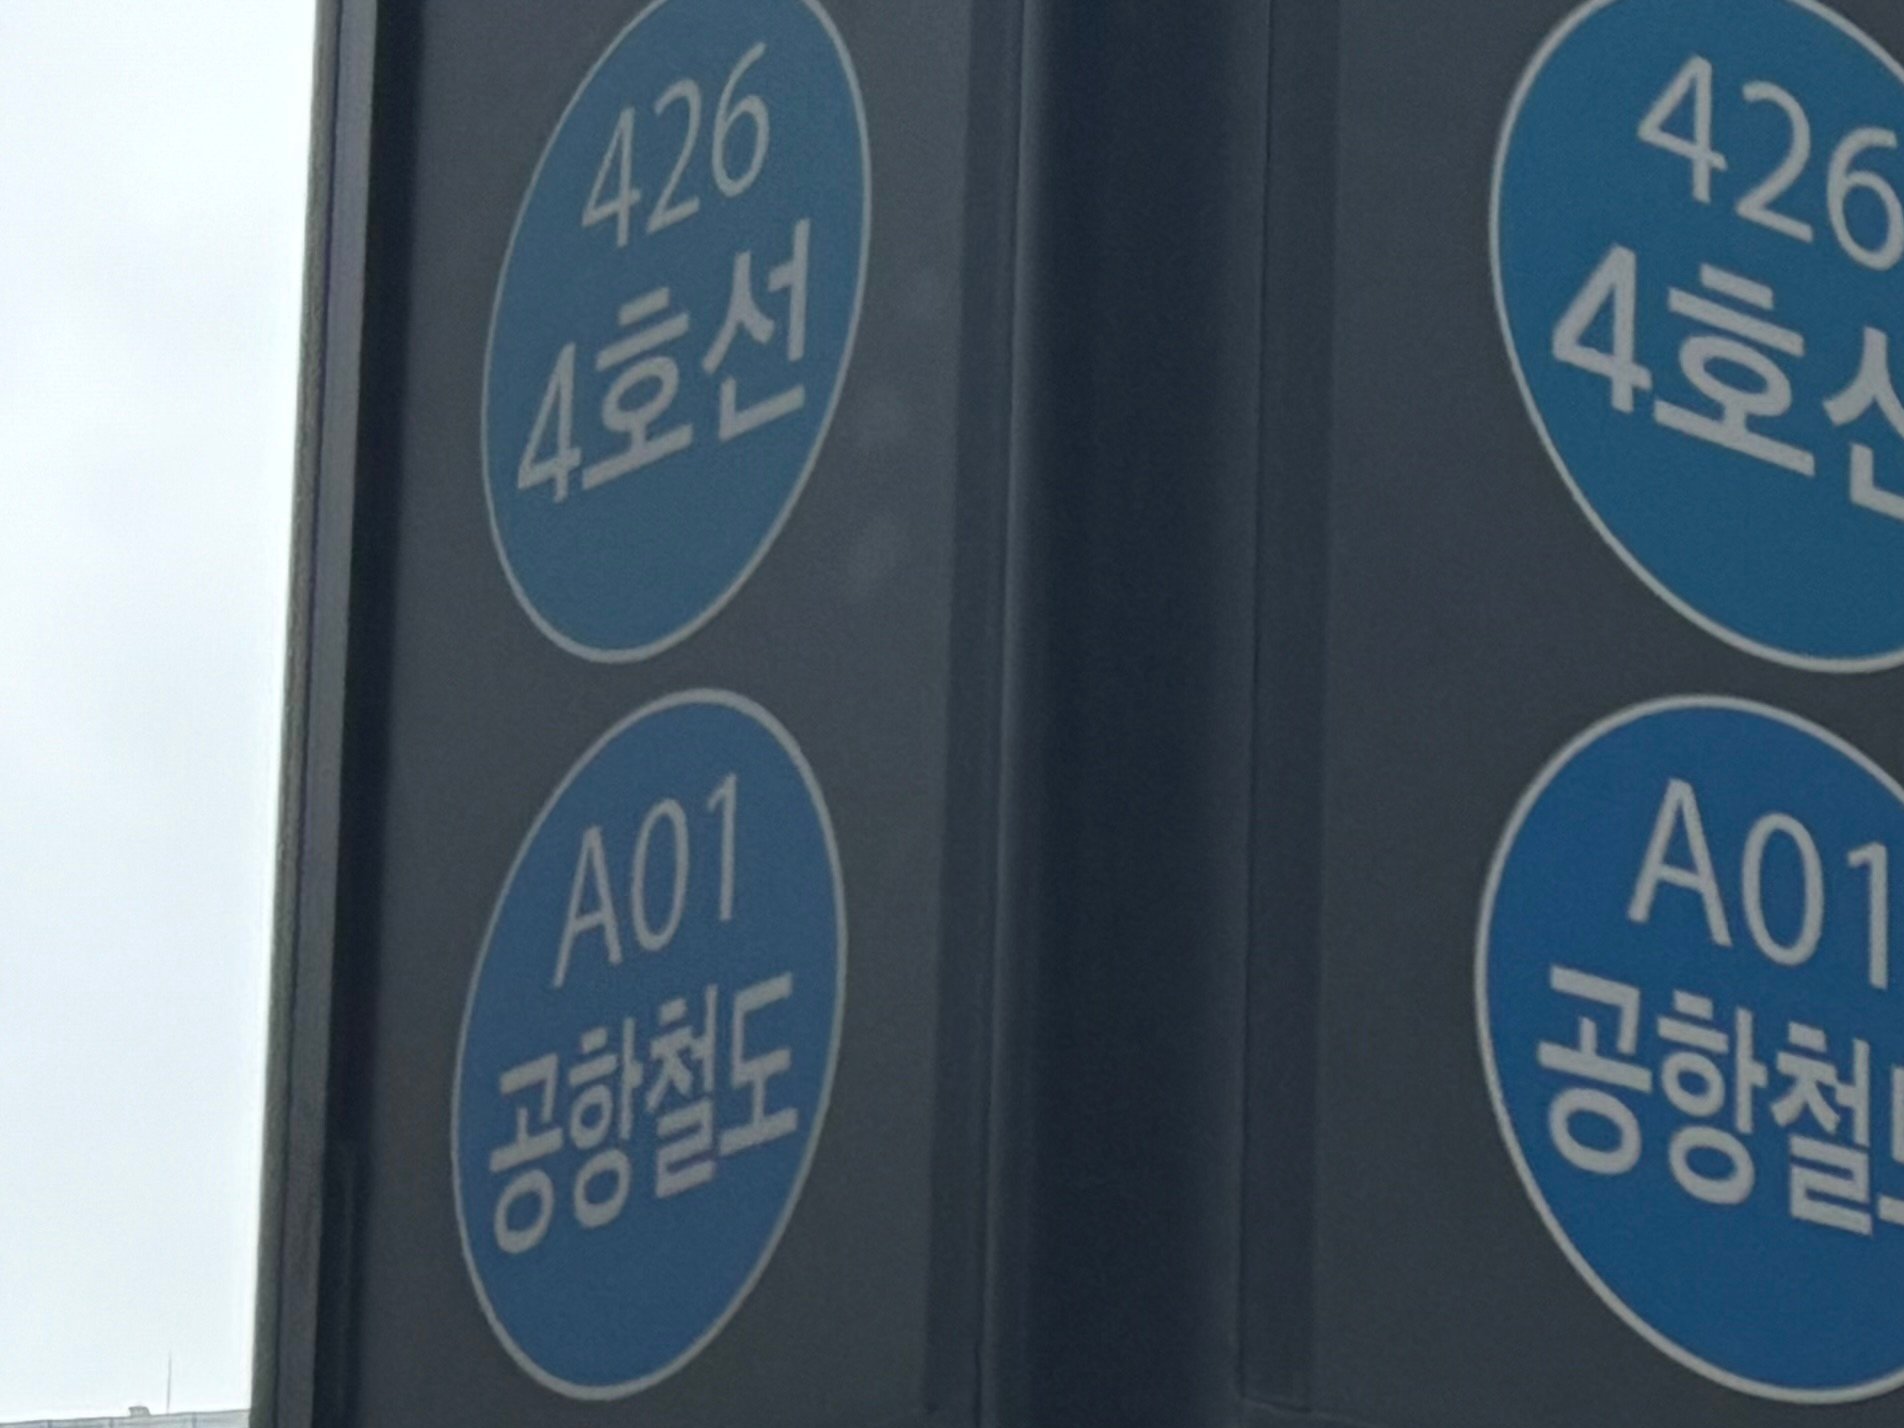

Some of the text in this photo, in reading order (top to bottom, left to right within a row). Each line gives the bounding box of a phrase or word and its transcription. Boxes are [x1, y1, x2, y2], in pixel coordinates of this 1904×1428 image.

[582, 42, 770, 250] 426
[515, 221, 812, 503] 4호선
[552, 774, 742, 988] A01
[1629, 777, 1892, 991] A01
[489, 974, 800, 1256] 공항철도
